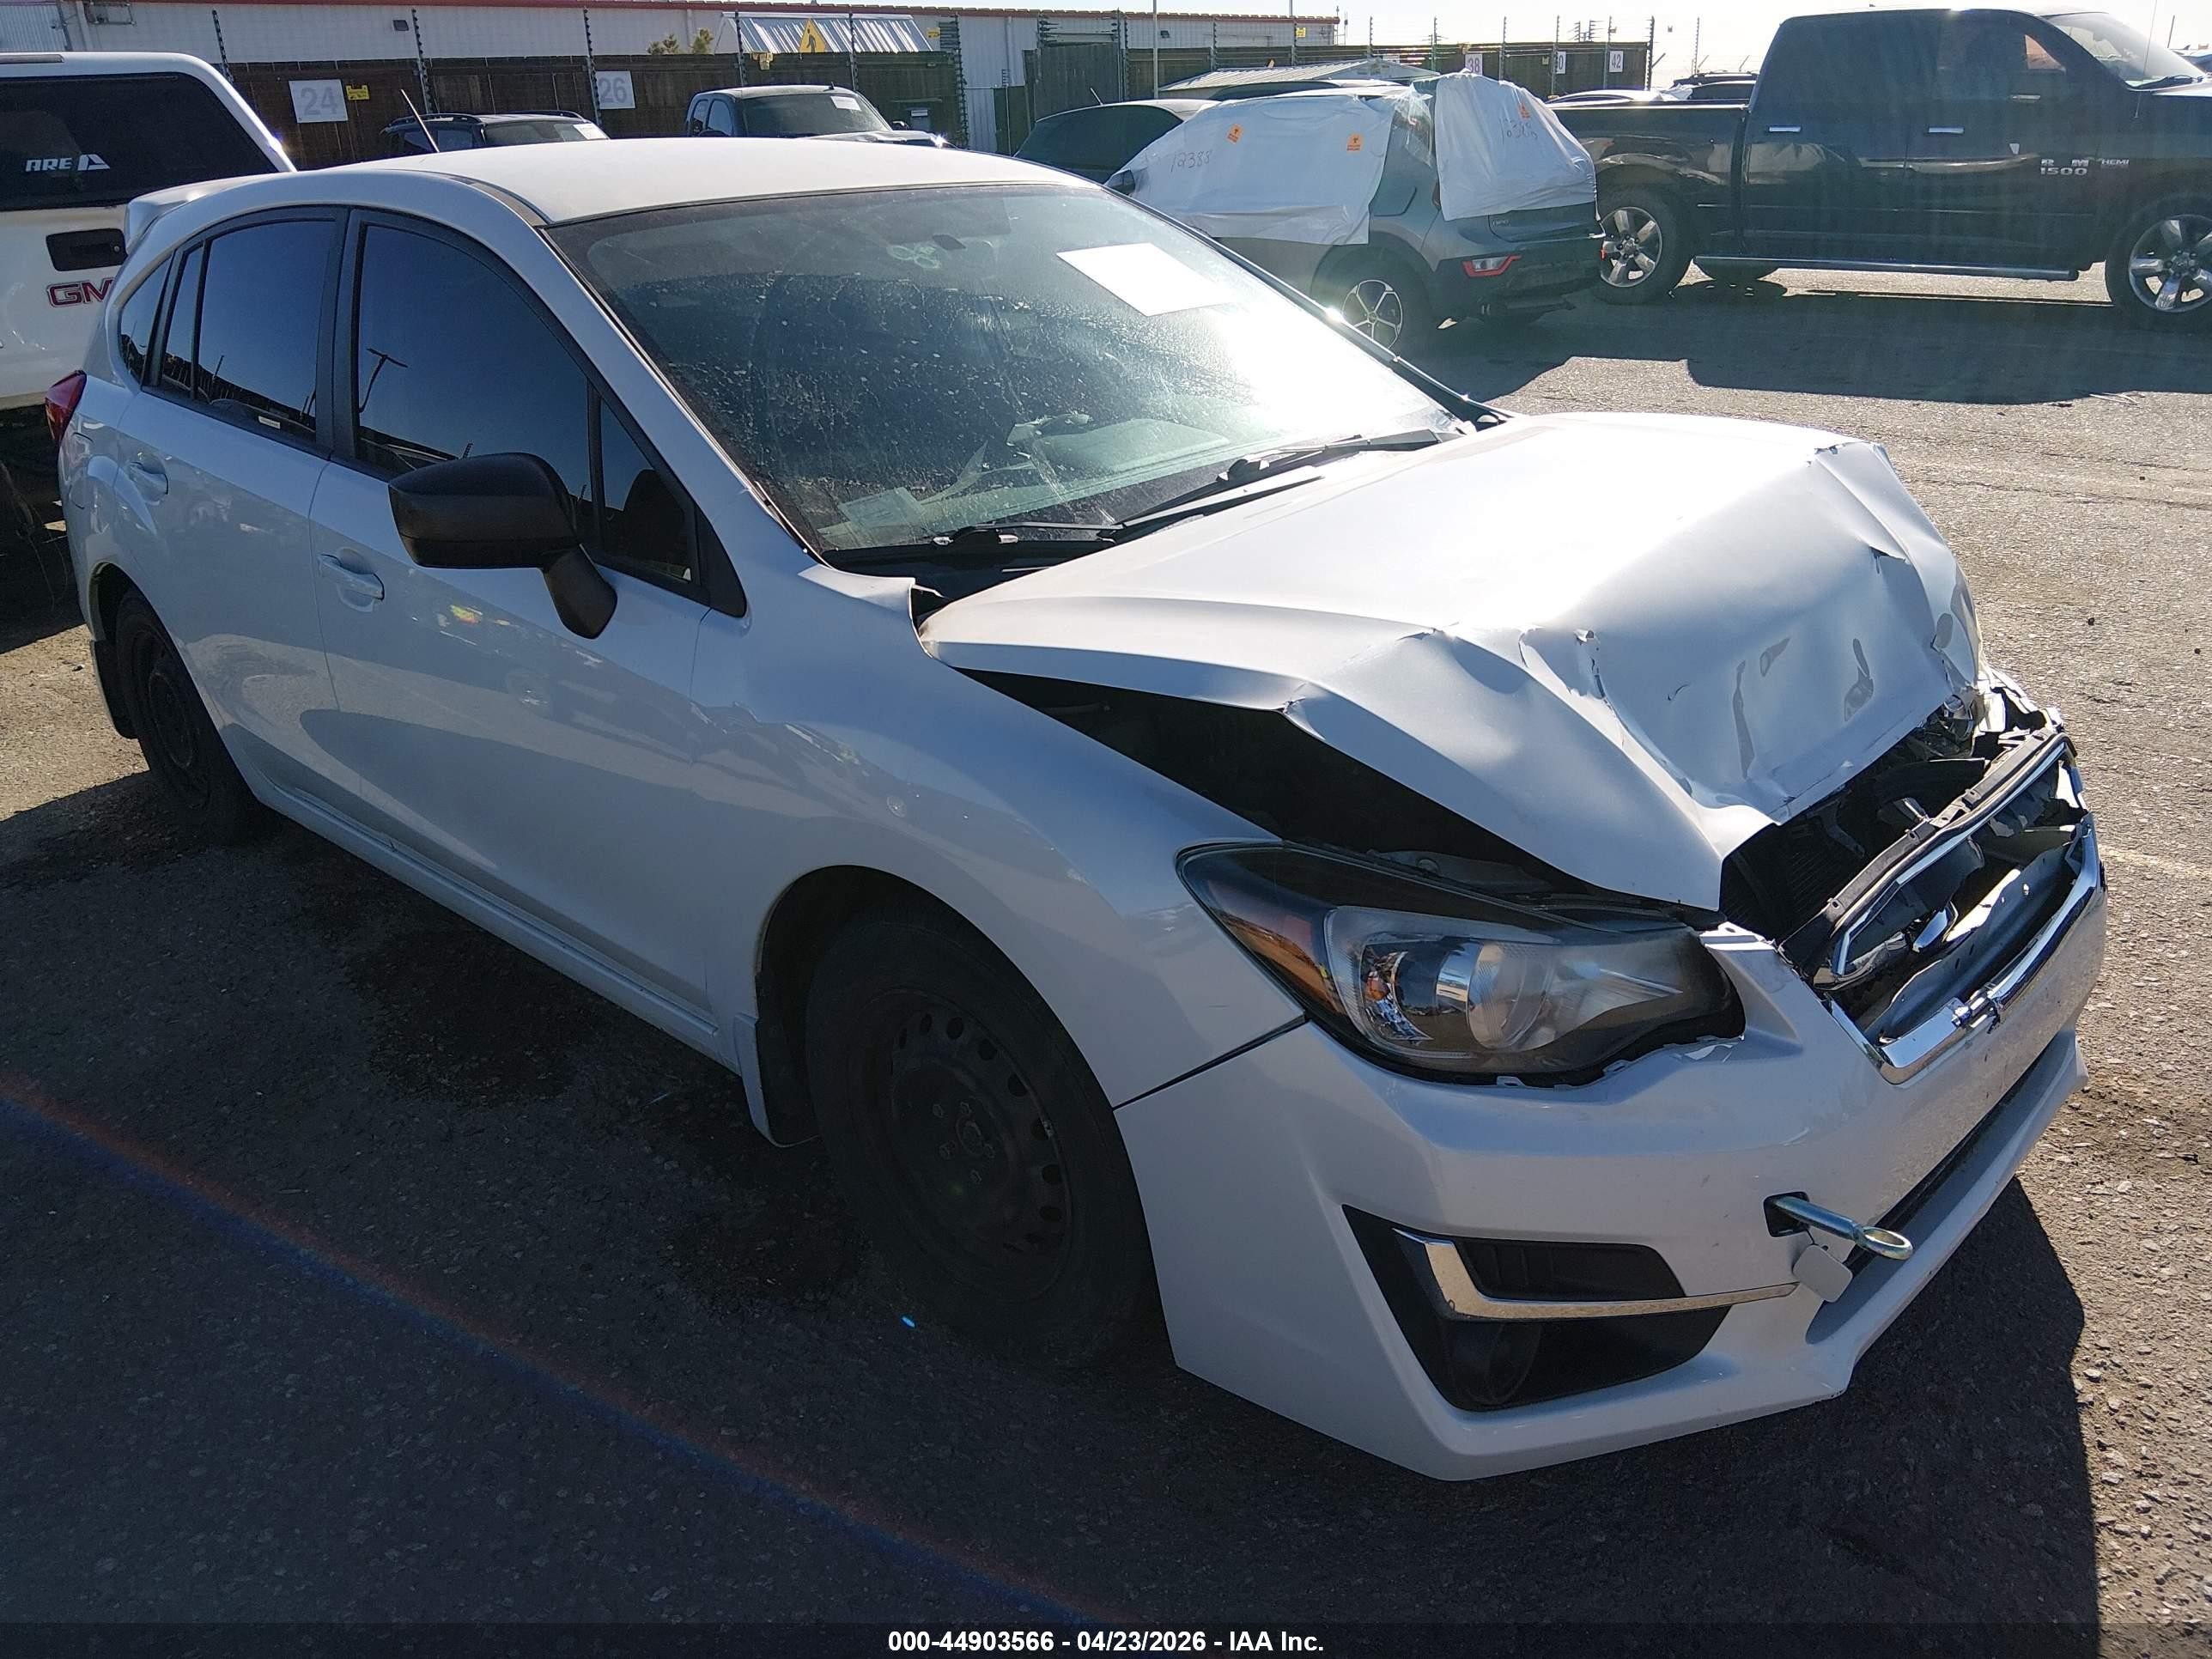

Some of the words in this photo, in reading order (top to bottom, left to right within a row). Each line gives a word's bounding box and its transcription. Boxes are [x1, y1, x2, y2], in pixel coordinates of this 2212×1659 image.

[1468, 58, 1480, 73] 38
[1612, 54, 1621, 68] 42
[599, 76, 628, 103] 26
[301, 87, 337, 115] 24
[25, 157, 72, 172] ARE
[2040, 167, 2087, 176] 1500
[46, 278, 115, 307] GM
